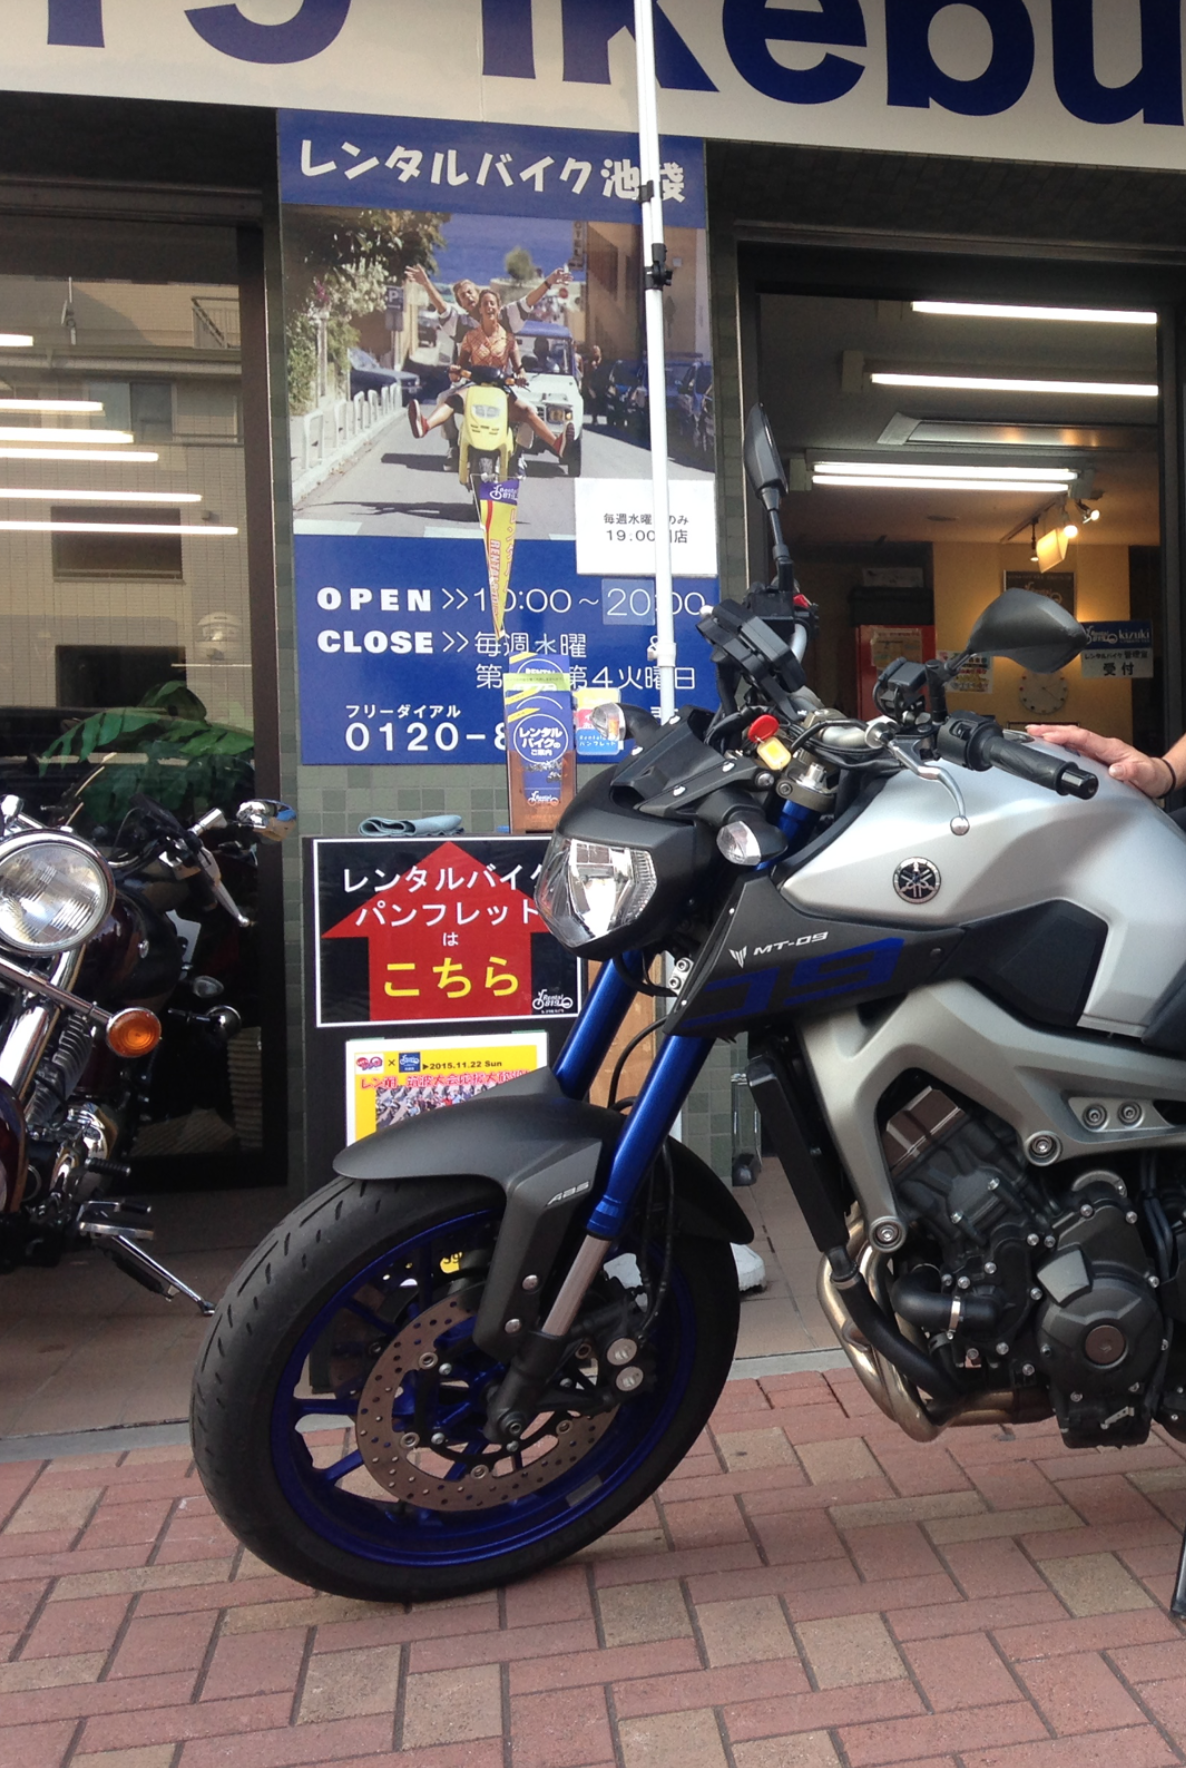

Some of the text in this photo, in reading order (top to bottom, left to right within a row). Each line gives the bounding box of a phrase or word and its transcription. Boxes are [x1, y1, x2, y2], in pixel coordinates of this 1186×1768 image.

[603, 512, 689, 526] 毎週水曜のみ
[317, 587, 431, 611] OPEN
[317, 631, 433, 653] CLOSE
[1103, 662, 1134, 676] 受付
[346, 704, 461, 719] フリーダイアル
[519, 727, 562, 738] レンタル
[355, 899, 539, 926] パンフレット
[442, 932, 459, 947] は
[753, 931, 829, 956] MT-09
[384, 956, 519, 998] こちら
[430, 1060, 482, 1070] 2015.11.22
